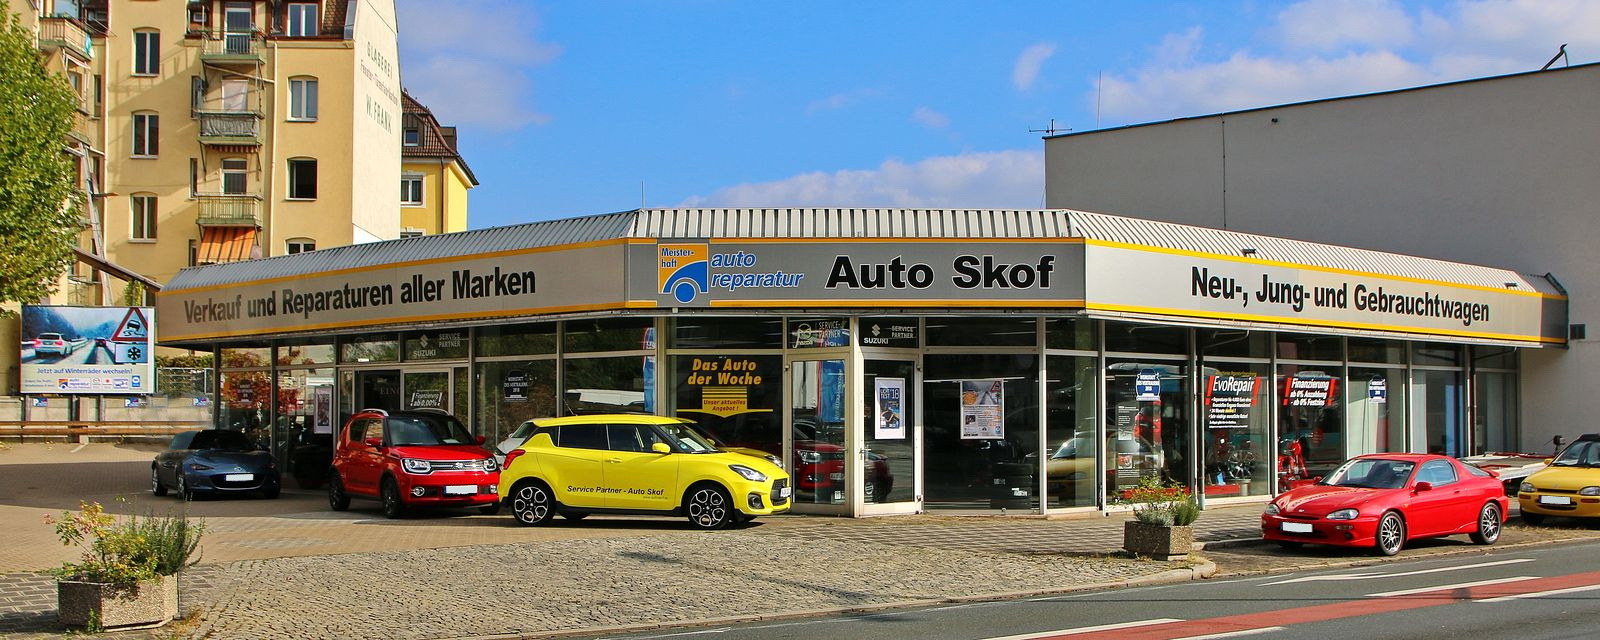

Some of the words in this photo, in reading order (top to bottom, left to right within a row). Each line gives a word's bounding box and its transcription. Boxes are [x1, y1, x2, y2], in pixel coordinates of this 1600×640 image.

[366, 41, 392, 79] GLASEREI
[661, 247, 695, 257] Meister-
[661, 258, 677, 268] haft
[711, 251, 757, 268] auto
[824, 254, 935, 290] Auto
[952, 254, 1056, 290] Skof
[710, 270, 804, 292] reparatur
[184, 294, 242, 324] Verkauf
[247, 290, 276, 318] und
[282, 283, 393, 319] Reparaturen
[400, 274, 445, 304] aller
[452, 266, 536, 300] Marken
[1191, 266, 1248, 308] Neu-,
[1255, 274, 1311, 312] Jung-
[1314, 282, 1348, 309] und
[1354, 284, 1490, 327] Gebrauchtwagen
[438, 340, 461, 348] PARTNER
[863, 337, 889, 345] SUZUKI
[413, 349, 437, 357] SUZUKI
[692, 358, 718, 371] Das
[722, 358, 757, 371] Auto
[687, 372, 712, 385] der
[718, 372, 762, 385] Woche
[1291, 378, 1330, 391] Finanzierung
[1212, 376, 1255, 396] EvoRepair
[567, 485, 594, 493] Service
[595, 486, 622, 494] Partner
[627, 487, 645, 495] Auto
[647, 488, 665, 496] Skof
